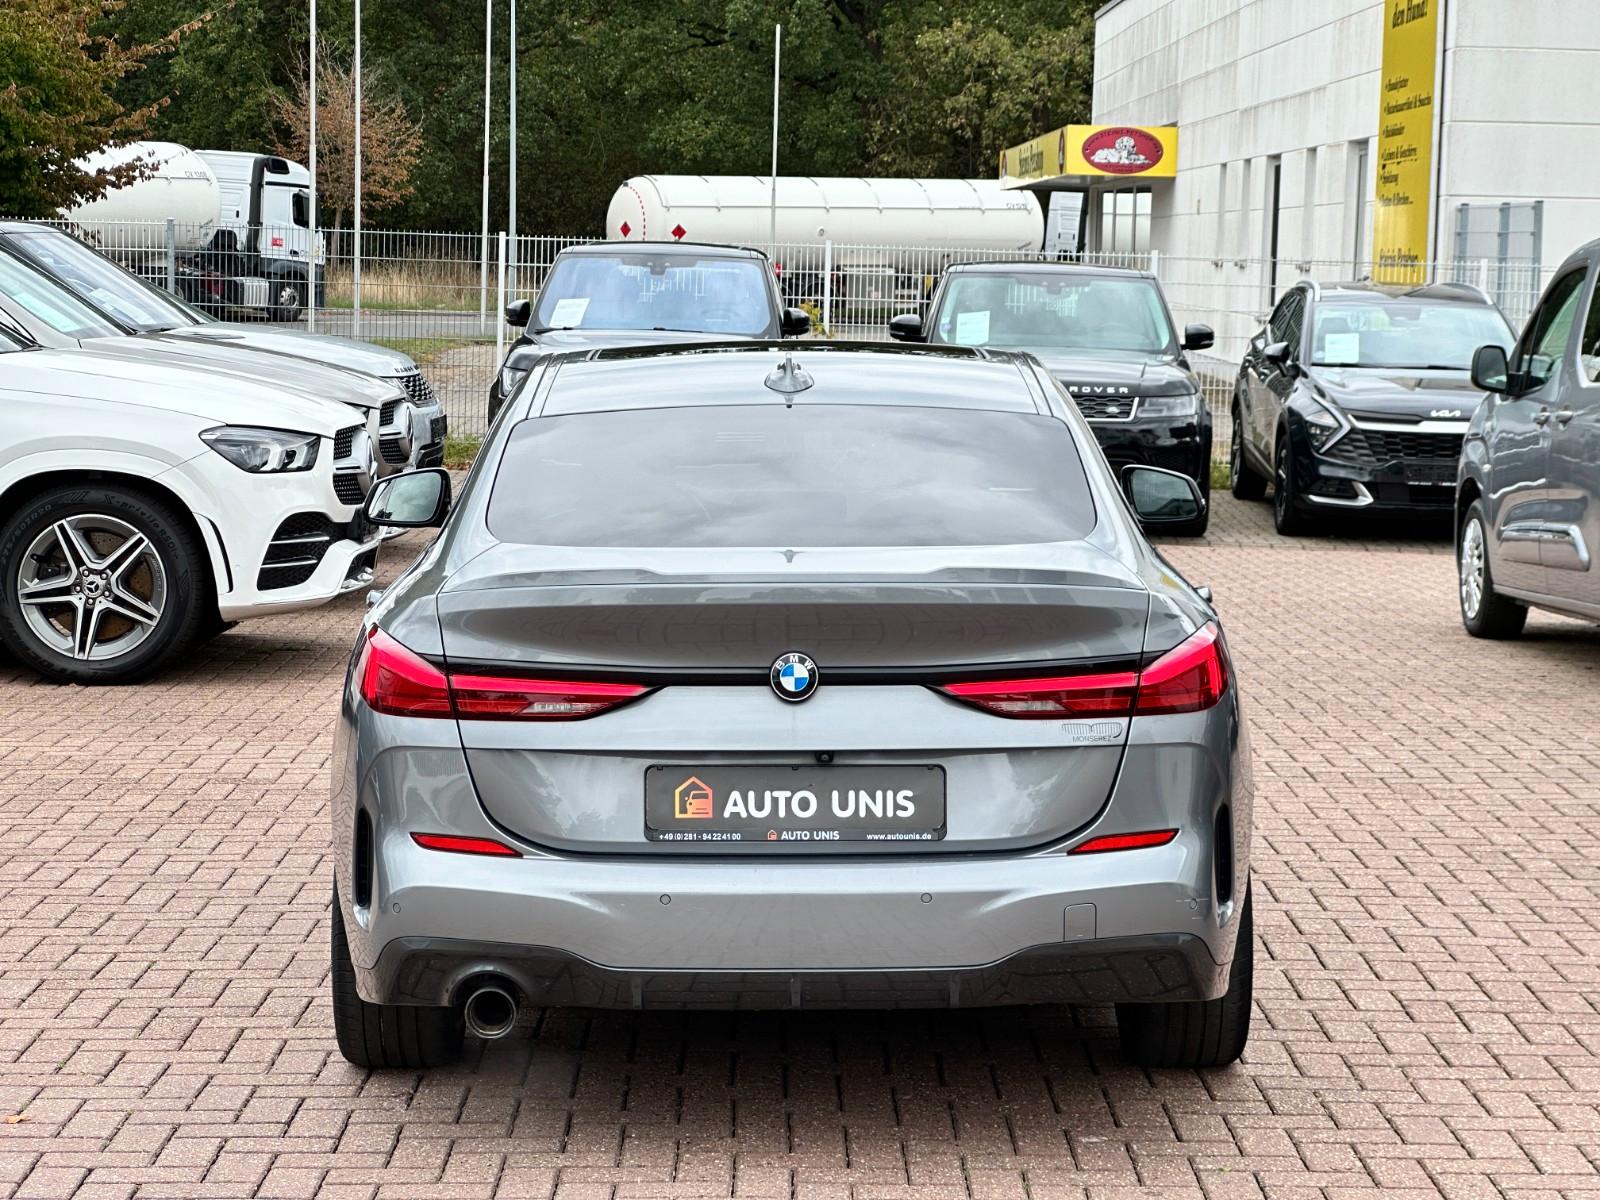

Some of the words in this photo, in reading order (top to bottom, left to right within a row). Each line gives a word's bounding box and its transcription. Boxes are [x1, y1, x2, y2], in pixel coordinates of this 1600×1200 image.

[1068, 385, 1129, 394] ROVER
[775, 654, 815, 670] BMW
[722, 789, 818, 819] AUTO
[831, 789, 916, 819] UNIS
[780, 830, 810, 841] AUTO
[813, 830, 841, 841] UNIS
[866, 832, 932, 841] www.autounis.de
